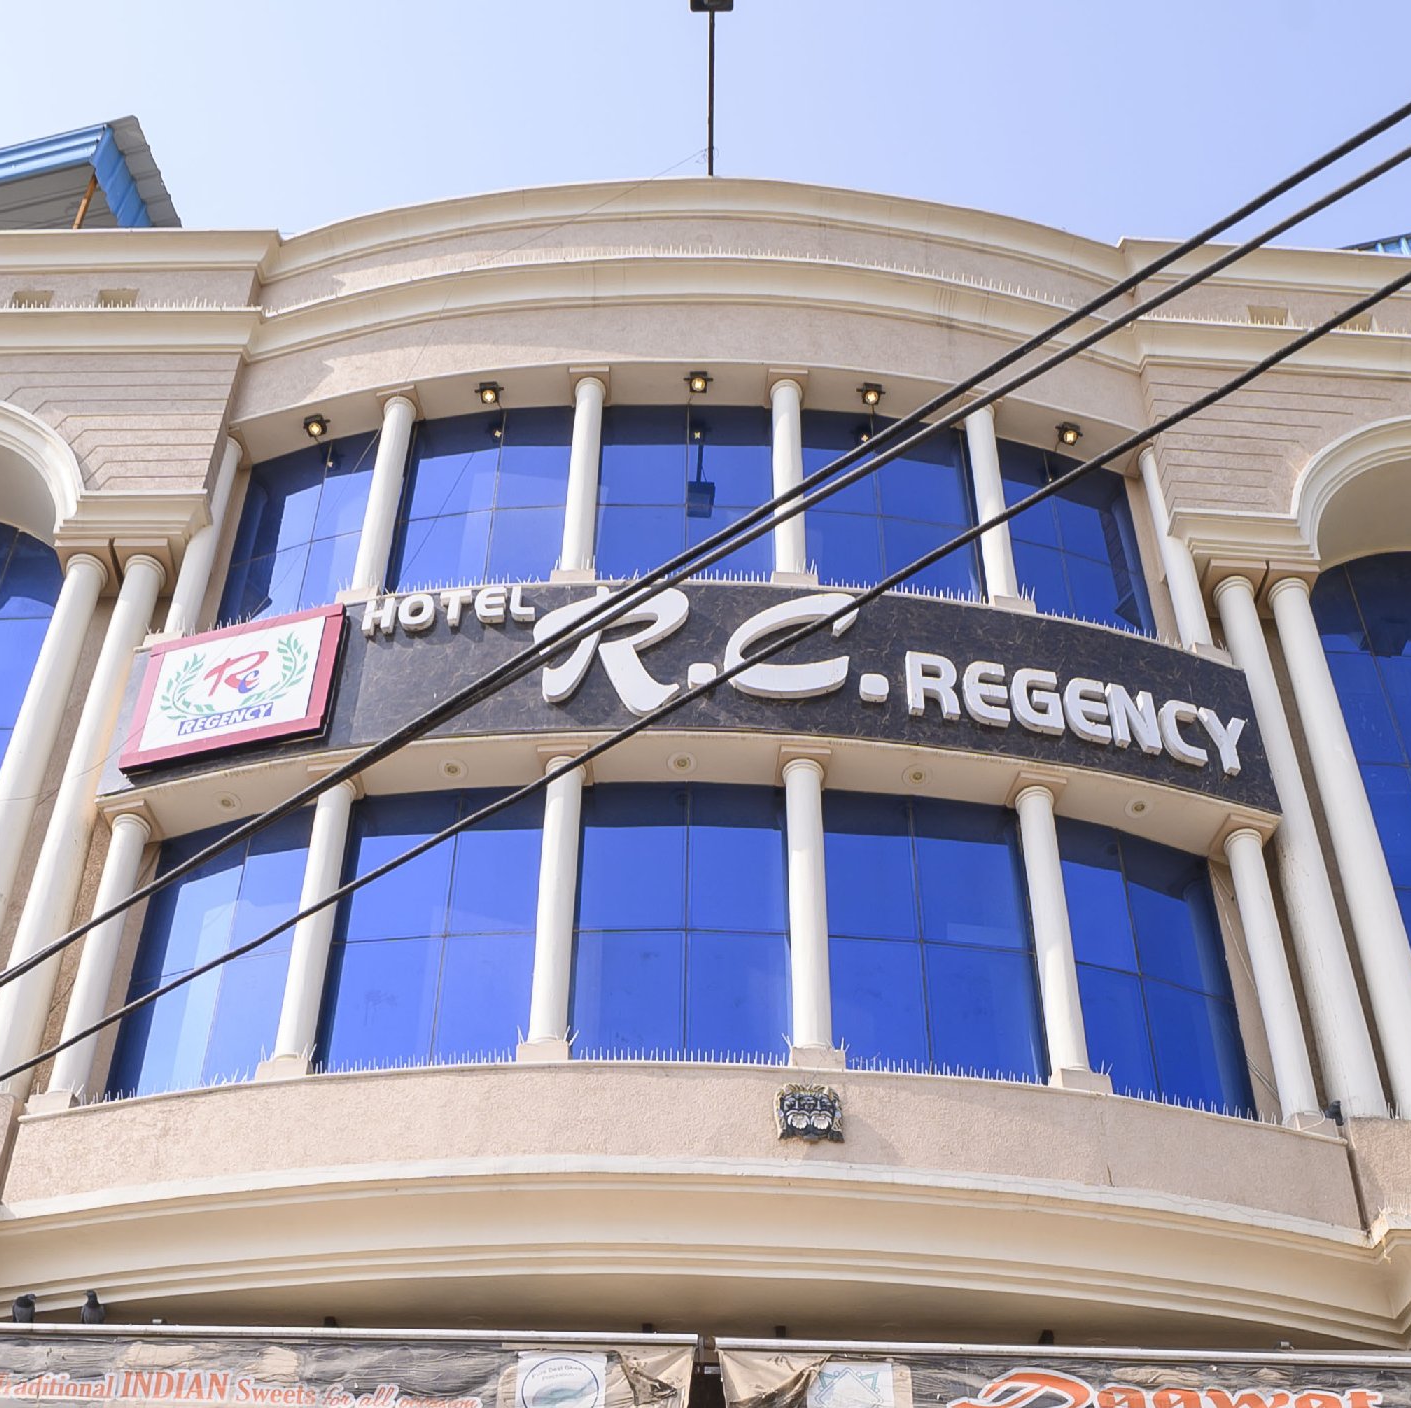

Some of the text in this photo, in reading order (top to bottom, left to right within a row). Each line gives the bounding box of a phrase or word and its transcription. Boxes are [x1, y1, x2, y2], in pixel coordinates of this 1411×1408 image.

[362, 586, 536, 637] HOTEL
[905, 650, 1248, 777] REGENCY
[179, 703, 271, 736] REGENCY
[120, 1370, 228, 1402] INDIAN
[235, 1377, 317, 1407] Sweets
[322, 1384, 352, 1406] for
[359, 1386, 396, 1408] all
